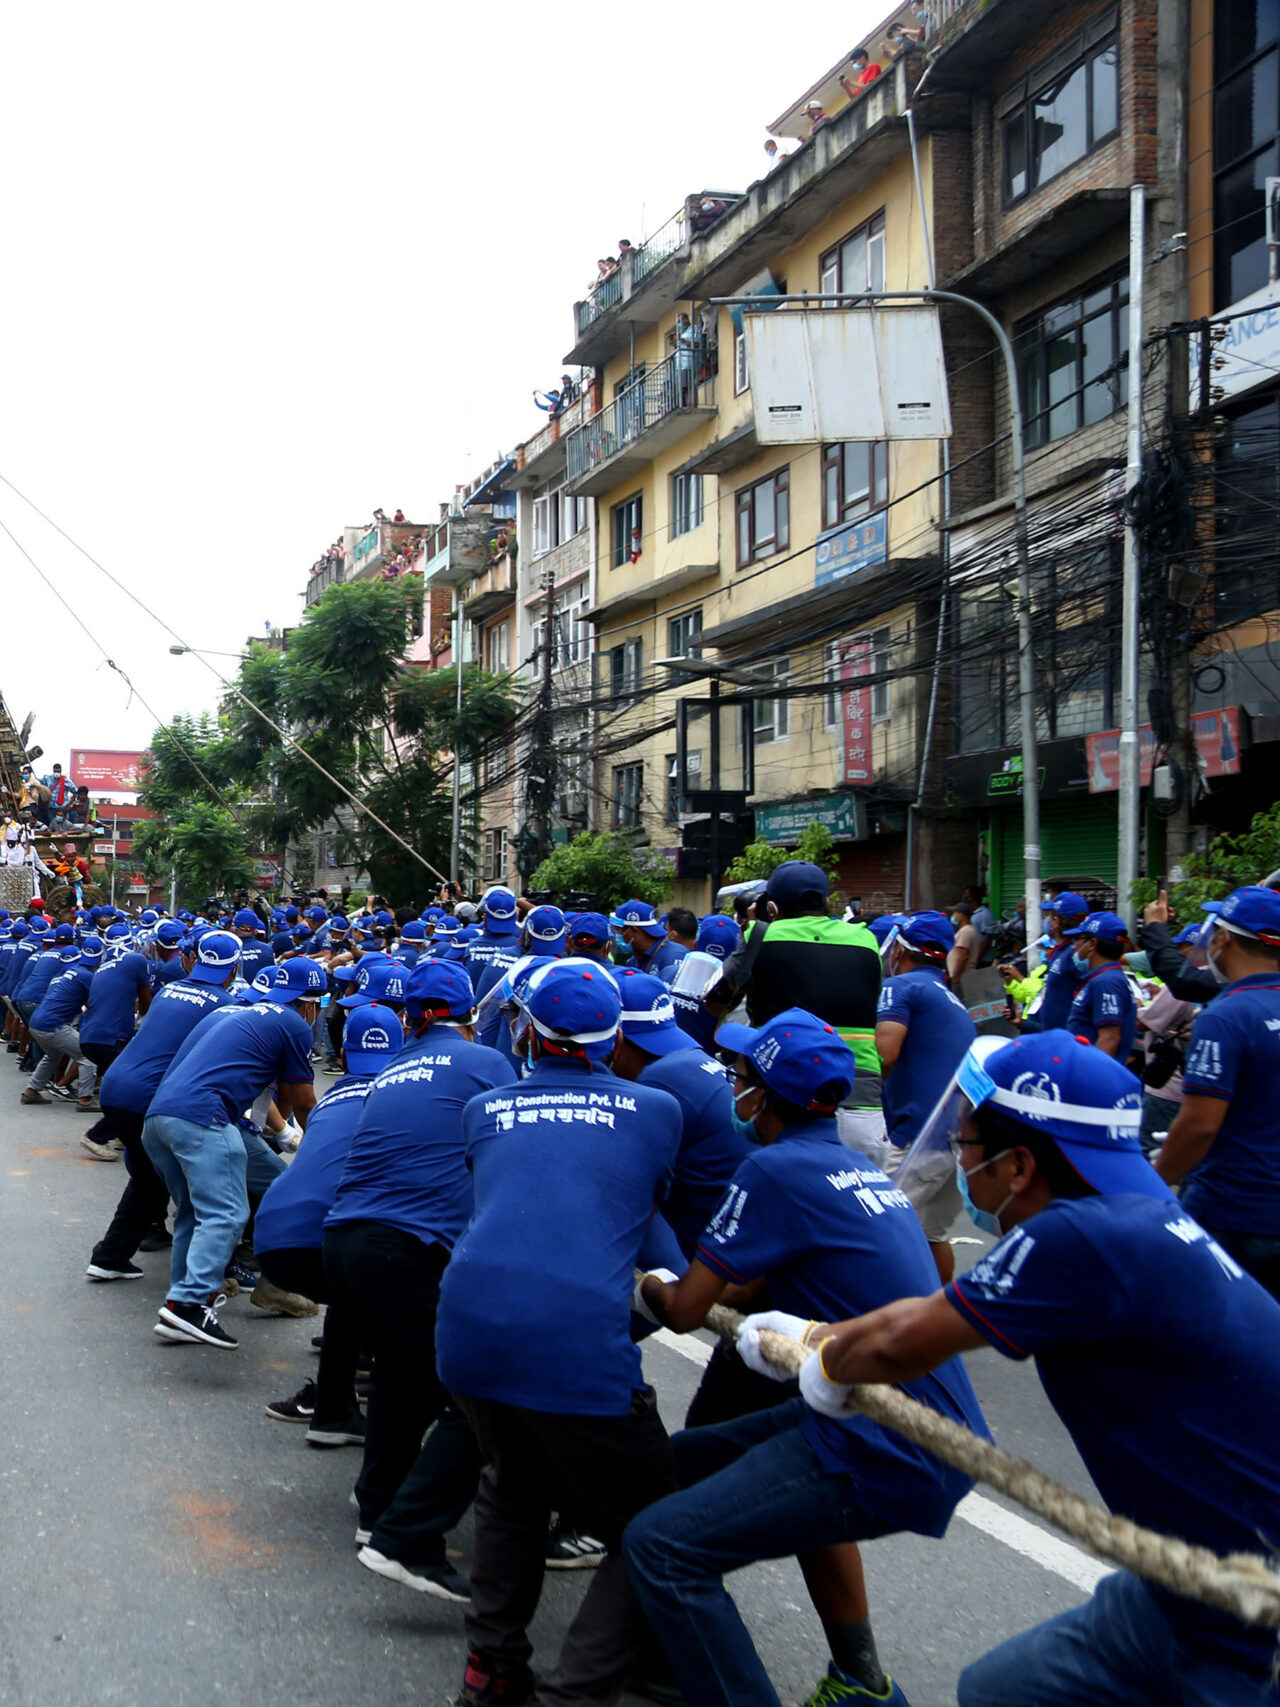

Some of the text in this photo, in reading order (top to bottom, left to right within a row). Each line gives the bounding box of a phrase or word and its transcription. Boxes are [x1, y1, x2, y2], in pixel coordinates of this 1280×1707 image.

[435, 1055, 452, 1066] Ltd.
[485, 1092, 637, 1115] Valley Construction Pvt. Ltd.
[825, 1167, 863, 1191] Valley
